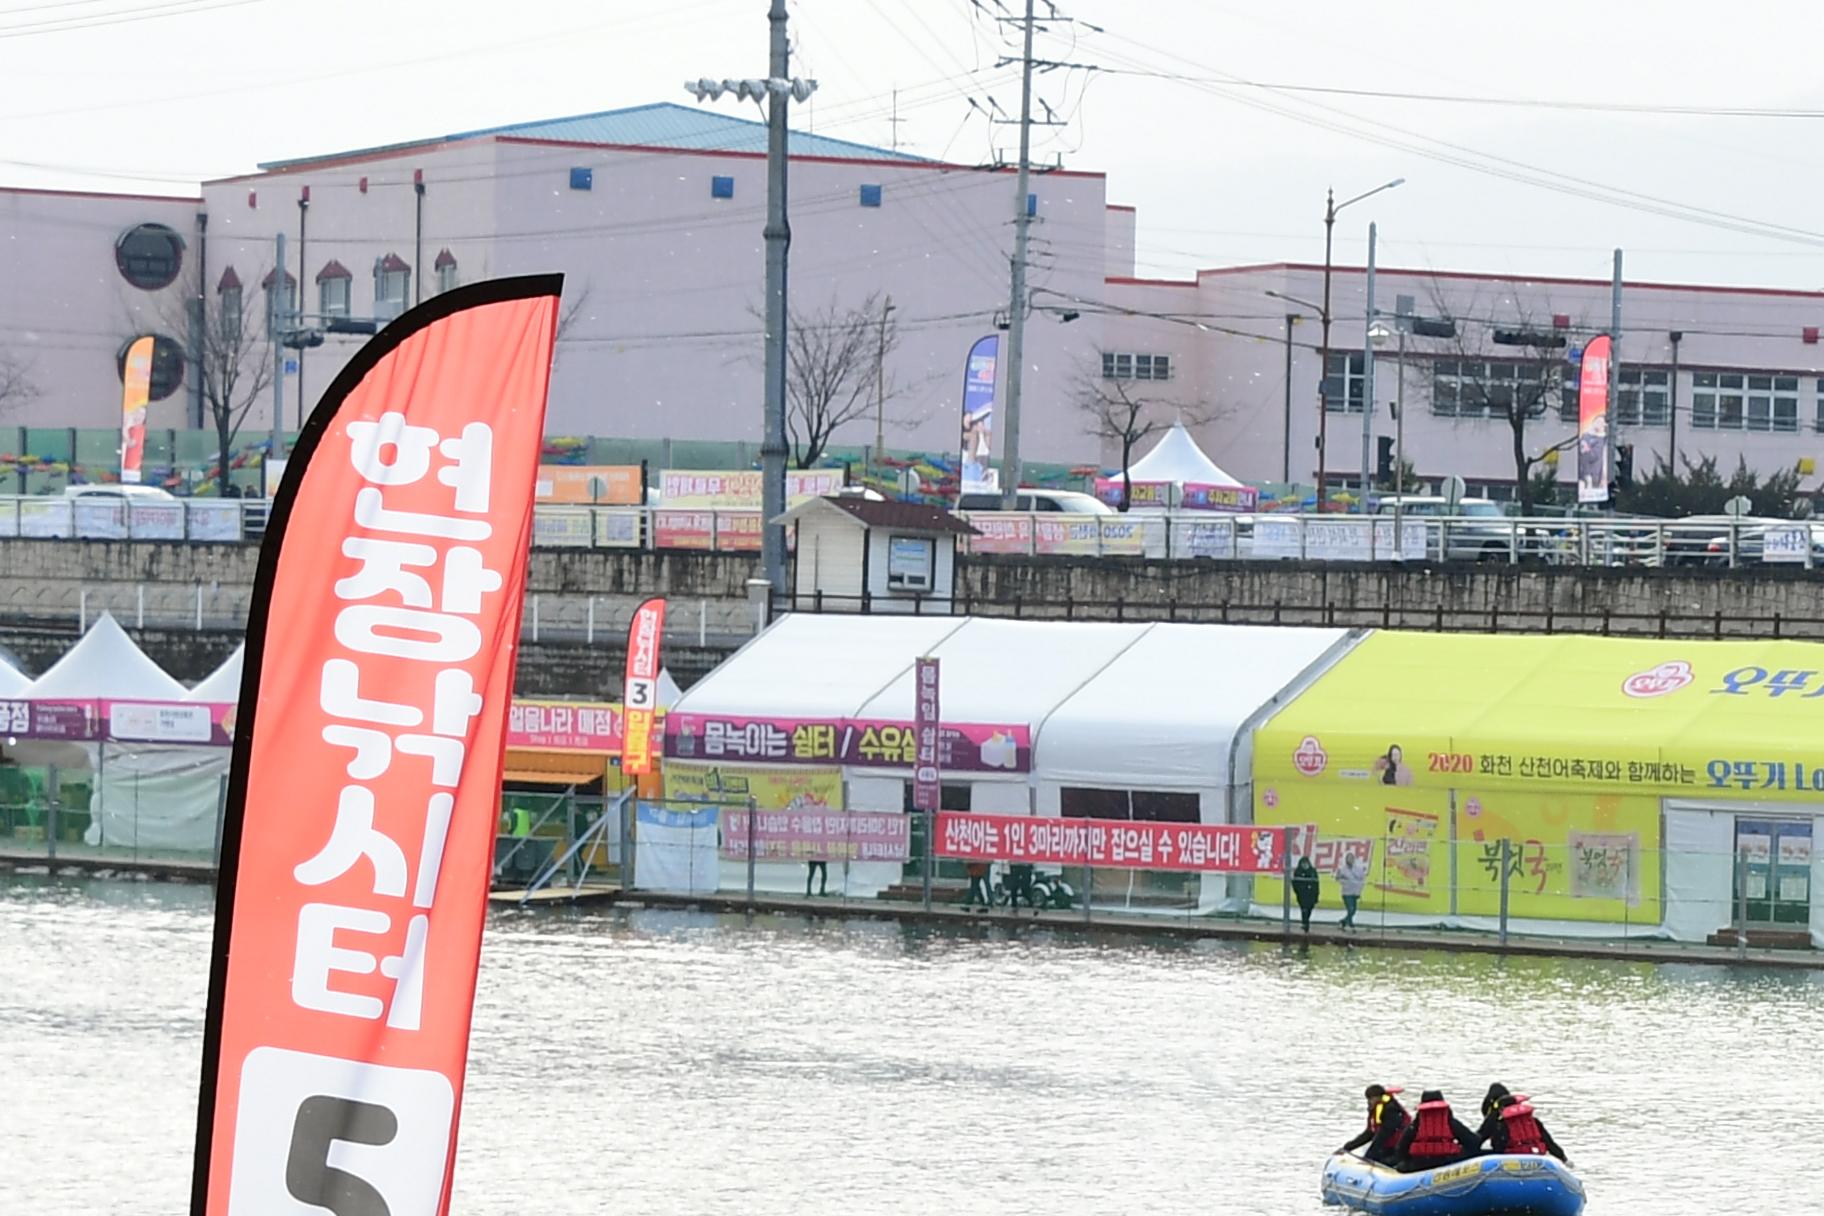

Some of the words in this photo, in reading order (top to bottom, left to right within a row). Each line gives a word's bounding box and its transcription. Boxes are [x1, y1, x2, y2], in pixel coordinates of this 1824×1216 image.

[632, 683, 648, 705] 3
[294, 411, 502, 1031] 현장낚시터
[578, 708, 611, 737] 매점
[704, 721, 787, 757] 몸녹이는
[792, 724, 834, 759] 쉼터
[1428, 752, 1473, 773] 2020
[1480, 754, 1513, 776] 화천
[1519, 757, 1622, 782] 산천어축제와
[1627, 761, 1695, 784] 함께하는
[1706, 759, 1786, 791] 오뚜기
[945, 818, 999, 853] 산천어는
[1003, 822, 1025, 855] 1인
[1029, 823, 1106, 860] 3마리까지만
[1111, 827, 1154, 862] 잡으실
[1157, 831, 1173, 861] 수
[1178, 831, 1240, 867] 있습니다!
